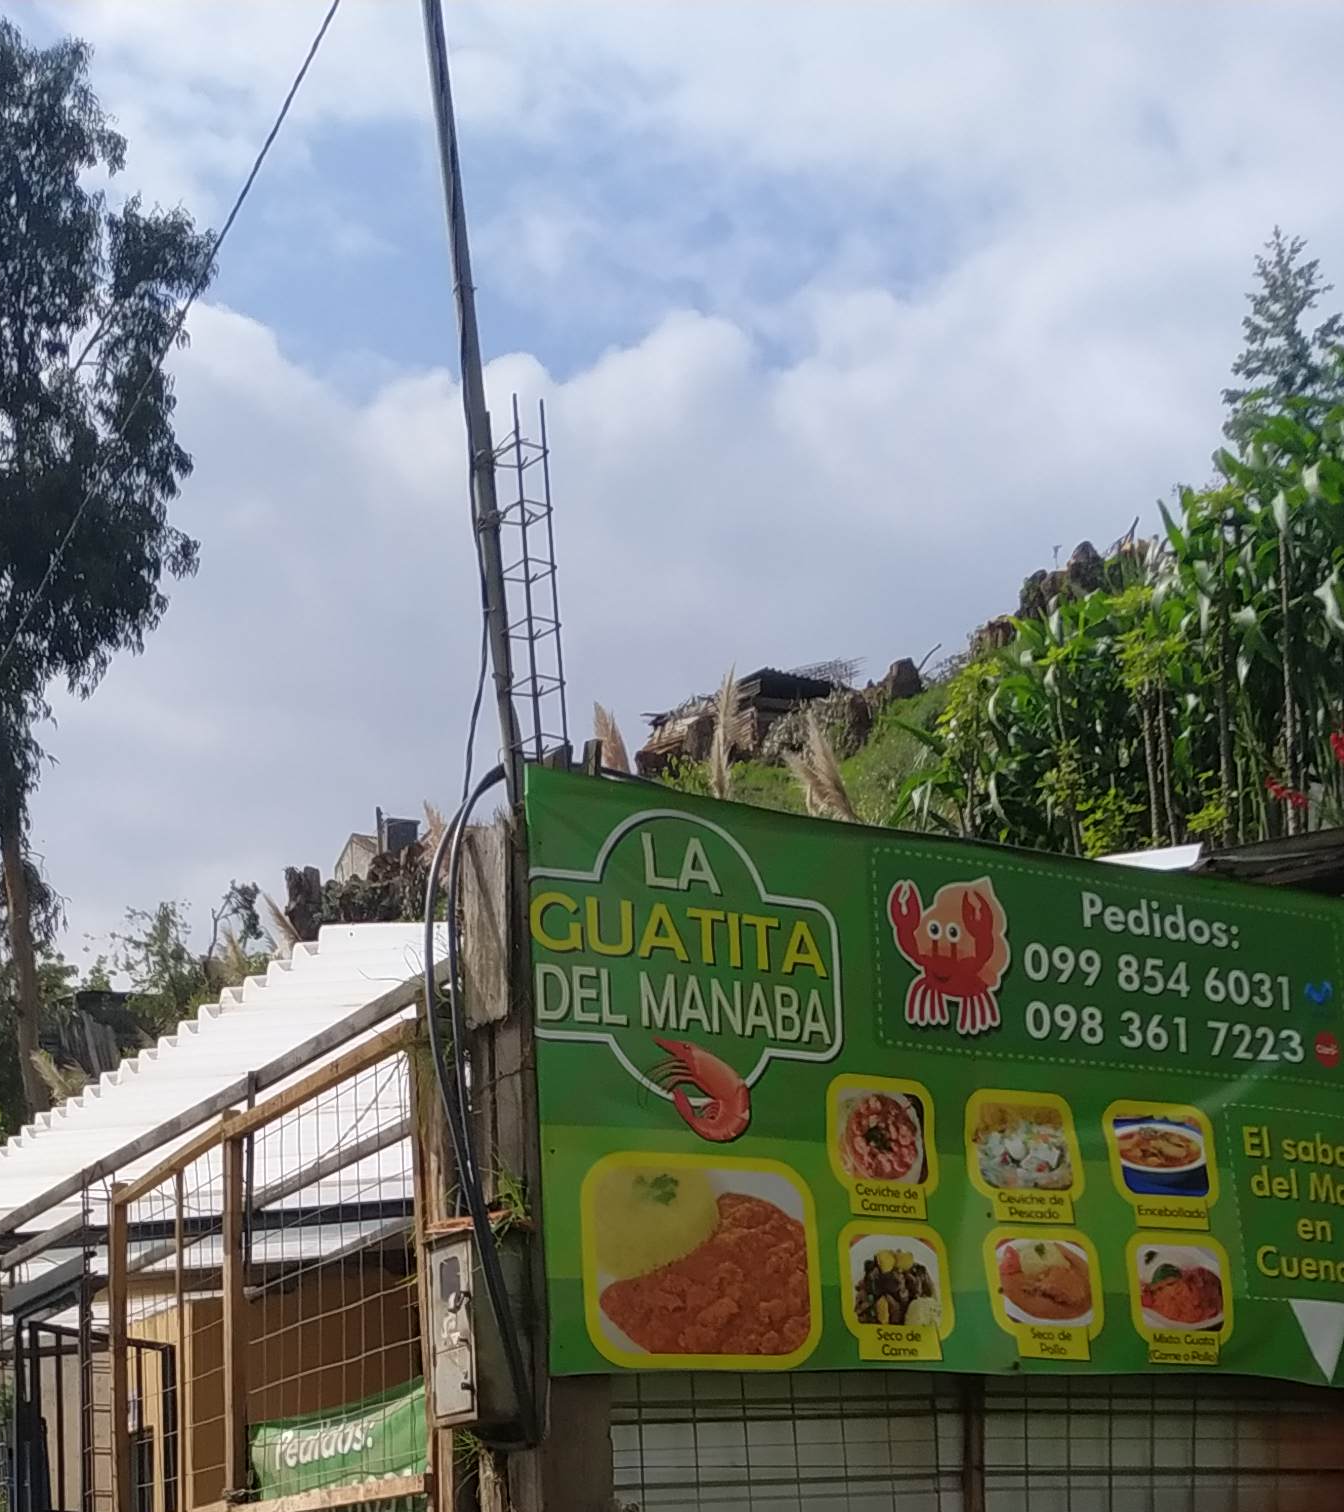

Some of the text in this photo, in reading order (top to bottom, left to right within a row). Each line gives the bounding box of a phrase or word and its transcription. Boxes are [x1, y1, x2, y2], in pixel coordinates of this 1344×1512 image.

[641, 831, 722, 895] LA
[1081, 891, 1240, 950] Pedidos:
[529, 891, 828, 978] GUATITA
[1024, 942, 1291, 1011] 099 854 6031
[535, 963, 833, 1045] DEL MANABA
[1025, 1001, 1305, 1063] 098 361 7223
[1242, 1125, 1272, 1159] El
[855, 1183, 919, 1200] Ceviche de
[1250, 1165, 1299, 1200] del
[997, 1191, 1065, 1207] Ceviche de
[1136, 1204, 1207, 1219] Encebollado
[1007, 1206, 1060, 1220] Pescado
[1296, 1216, 1333, 1243] en
[876, 1328, 922, 1343] Seco de
[1030, 1327, 1072, 1342] Seco de
[881, 1343, 919, 1357] Carne
[1039, 1342, 1067, 1356] Pollo
